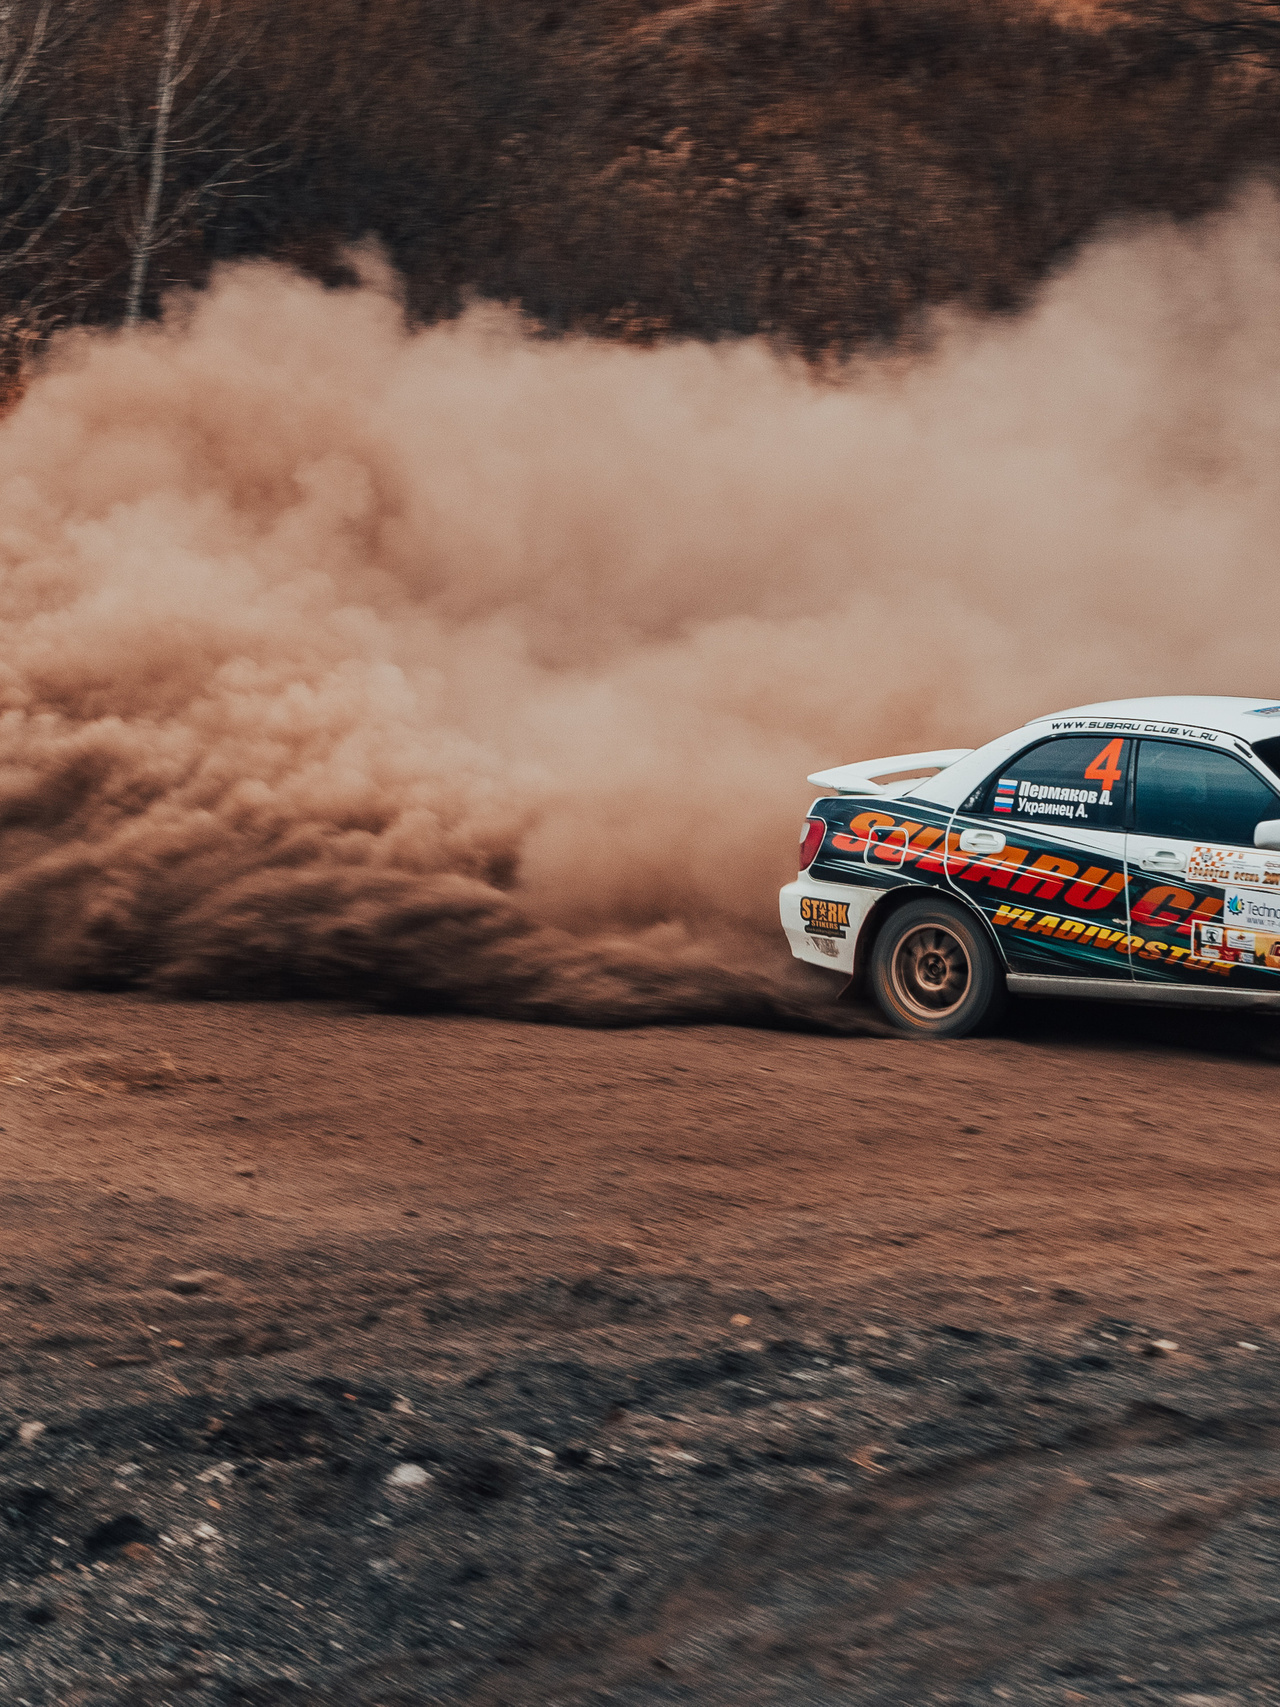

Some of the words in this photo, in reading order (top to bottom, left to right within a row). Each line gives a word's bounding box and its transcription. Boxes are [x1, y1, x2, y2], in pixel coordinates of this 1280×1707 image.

[1051, 721, 1141, 731] WWW.SUBARU
[1144, 724, 1218, 742] CLUB.VL.RU
[1084, 738, 1124, 791] 4
[1018, 781, 1099, 805] Пермяков
[1017, 797, 1074, 819] Украинец
[832, 812, 1133, 910] SUBARU
[801, 898, 848, 924] STARK
